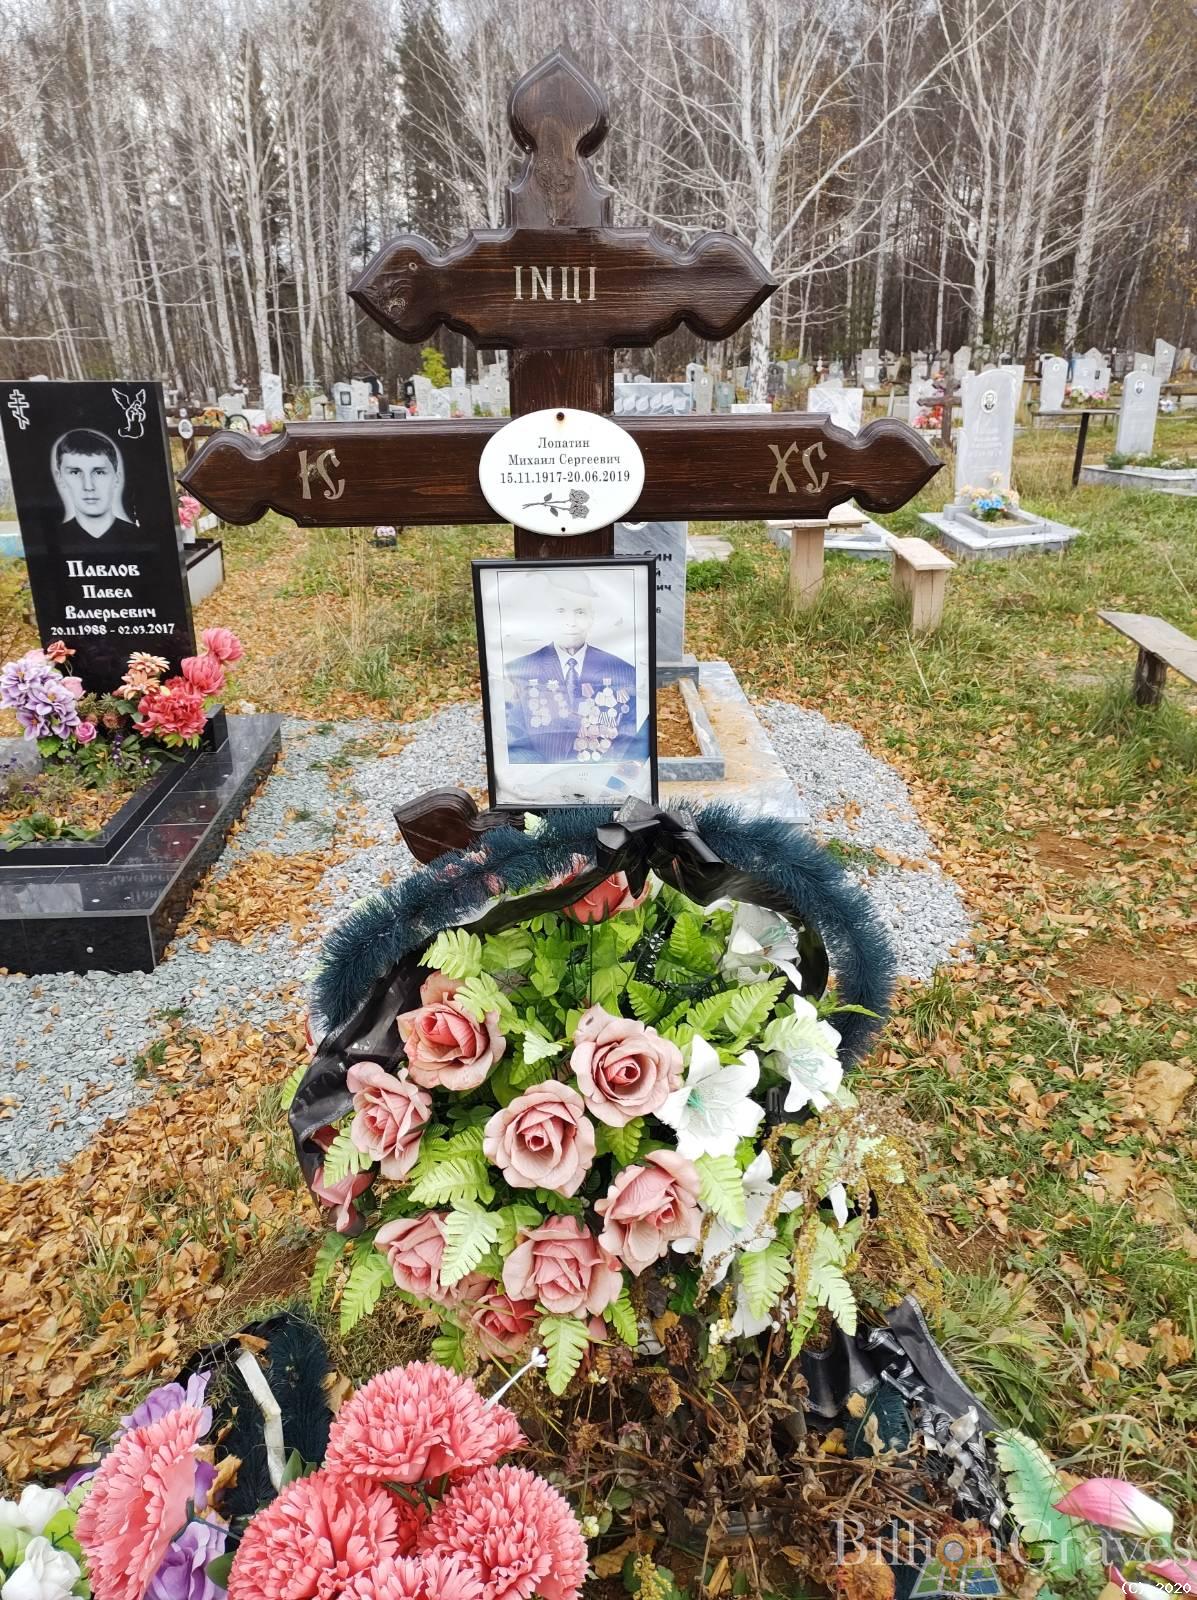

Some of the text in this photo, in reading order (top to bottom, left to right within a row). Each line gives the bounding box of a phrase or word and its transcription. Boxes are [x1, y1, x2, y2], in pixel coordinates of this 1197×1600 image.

[538, 437, 590, 449] Лопатин
[508, 453, 621, 467] Михаил Сергеевич
[500, 470, 631, 484] 15.11.1917-20.06.2019
[66, 560, 140, 577] Павлов
[81, 584, 133, 599] Павел
[65, 605, 157, 622] Валерьевич
[50, 624, 107, 636] 20.11.1988
[117, 623, 175, 635] 02.03.2017
